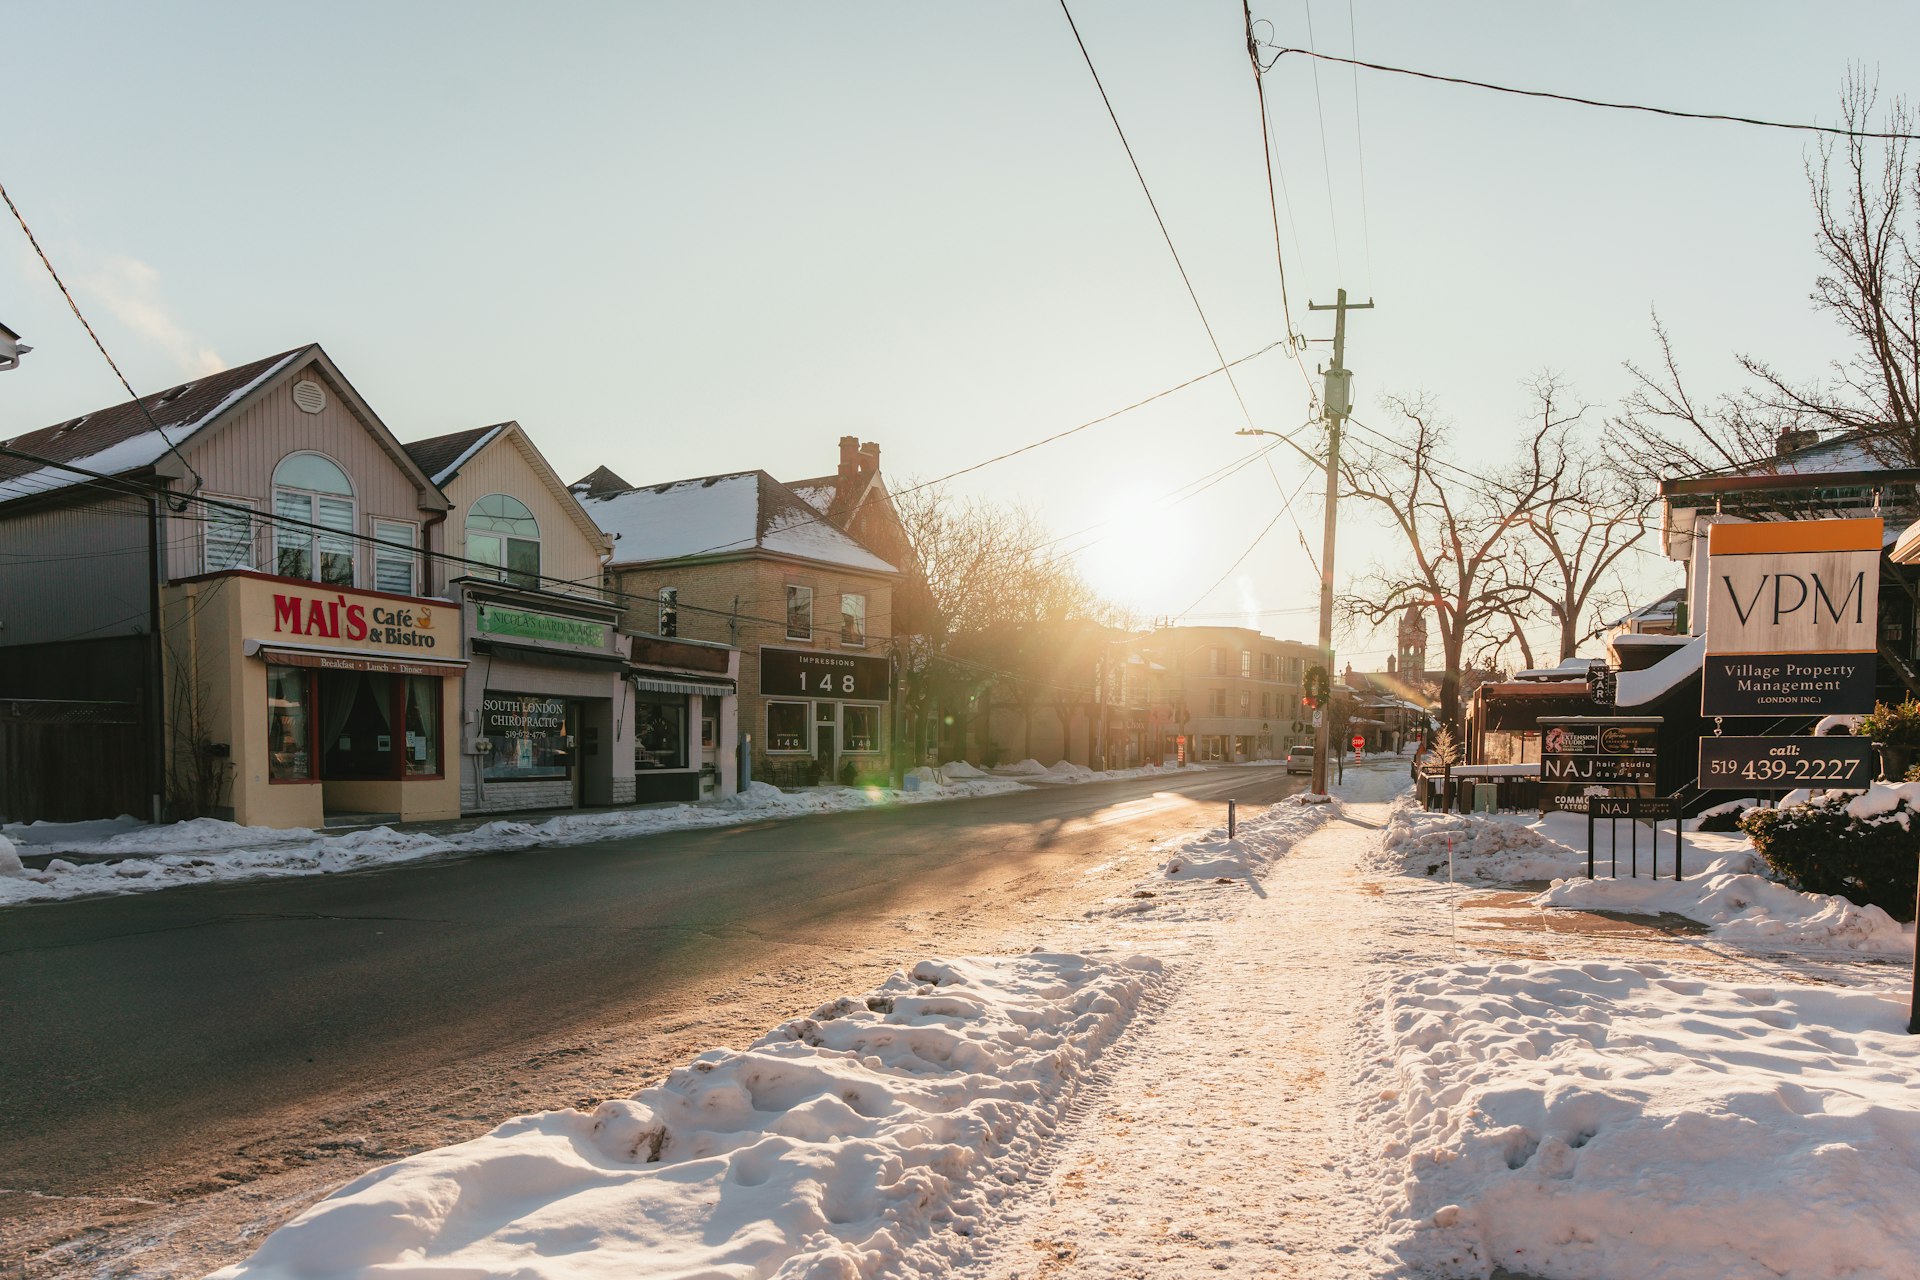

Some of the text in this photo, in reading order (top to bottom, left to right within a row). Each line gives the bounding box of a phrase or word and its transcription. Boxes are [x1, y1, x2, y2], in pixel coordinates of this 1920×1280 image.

[1722, 572, 1865, 627] VPM
[273, 594, 367, 641] MAI'S
[373, 607, 413, 628] Café
[494, 612, 536, 628] NICOLA'S
[539, 619, 575, 633] GARDEN
[369, 627, 435, 648] & Bistro
[320, 658, 423, 674] Breakfast Lunch Dinner
[1724, 664, 1856, 680] Village Property
[1595, 671, 1605, 698] BAR
[1737, 680, 1841, 694] Management
[484, 699, 563, 715] SOUTH LONDON
[1757, 696, 1822, 704] (LONDON INC.)
[490, 714, 558, 728] CHIROPRACTIC
[1769, 744, 1801, 756] call:
[1545, 760, 1593, 777] NAJ
[1596, 770, 1618, 778] day
[1710, 759, 1861, 781] 519 439-2227
[1600, 803, 1630, 815] NAJ
